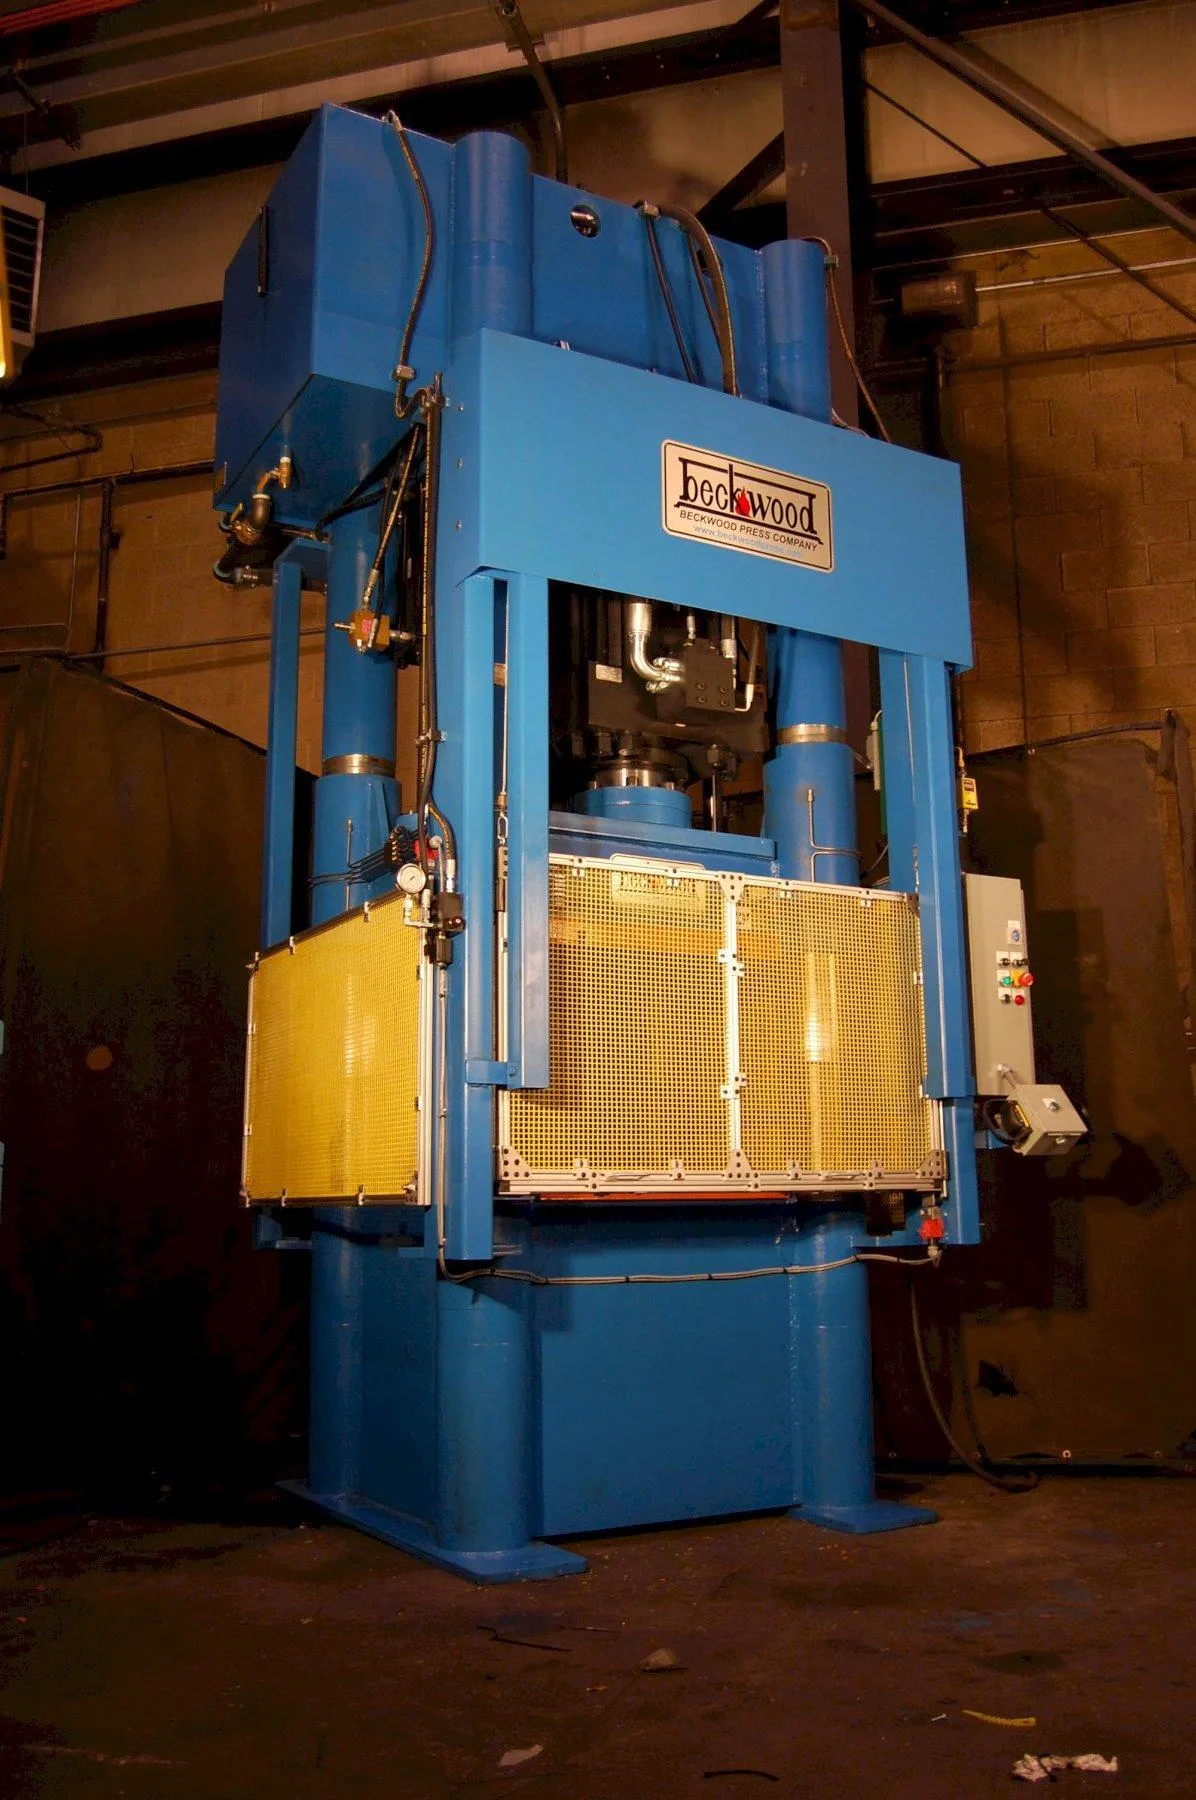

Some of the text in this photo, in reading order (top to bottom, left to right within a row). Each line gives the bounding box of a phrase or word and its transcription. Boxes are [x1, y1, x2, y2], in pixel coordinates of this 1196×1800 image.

[678, 457, 818, 535] beckwood
[679, 510, 818, 552] BECKWOOD PRESS COMPANY
